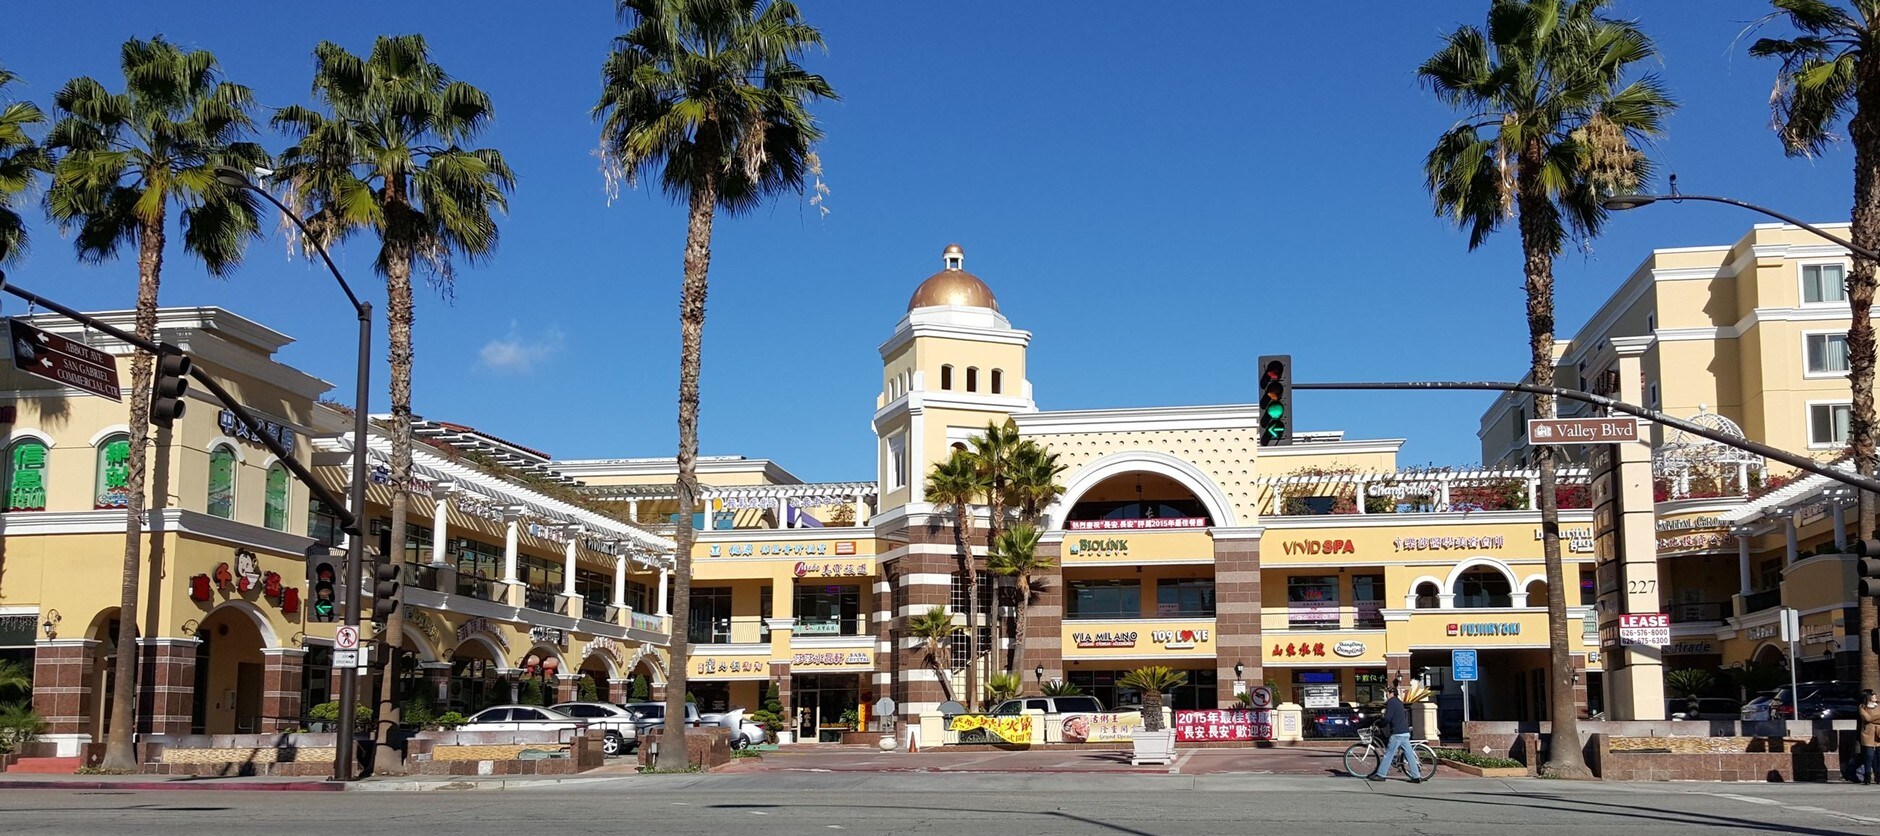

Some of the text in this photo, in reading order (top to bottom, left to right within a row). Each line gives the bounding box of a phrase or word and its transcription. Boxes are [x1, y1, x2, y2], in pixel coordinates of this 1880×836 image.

[64, 342, 104, 363] ABBOT AVE
[63, 358, 110, 382] SAN GABRIEL
[57, 369, 119, 397] COMMERCIAL CTR
[1556, 422, 1633, 440] Valley Blvd
[1321, 539, 1355, 555] SPA
[1628, 580, 1656, 594] 227
[1620, 615, 1668, 628] LEASE
[1073, 631, 1138, 642] VIA MILANO
[1152, 630, 1174, 642] 109
[1621, 629, 1668, 637] 626-576-8000
